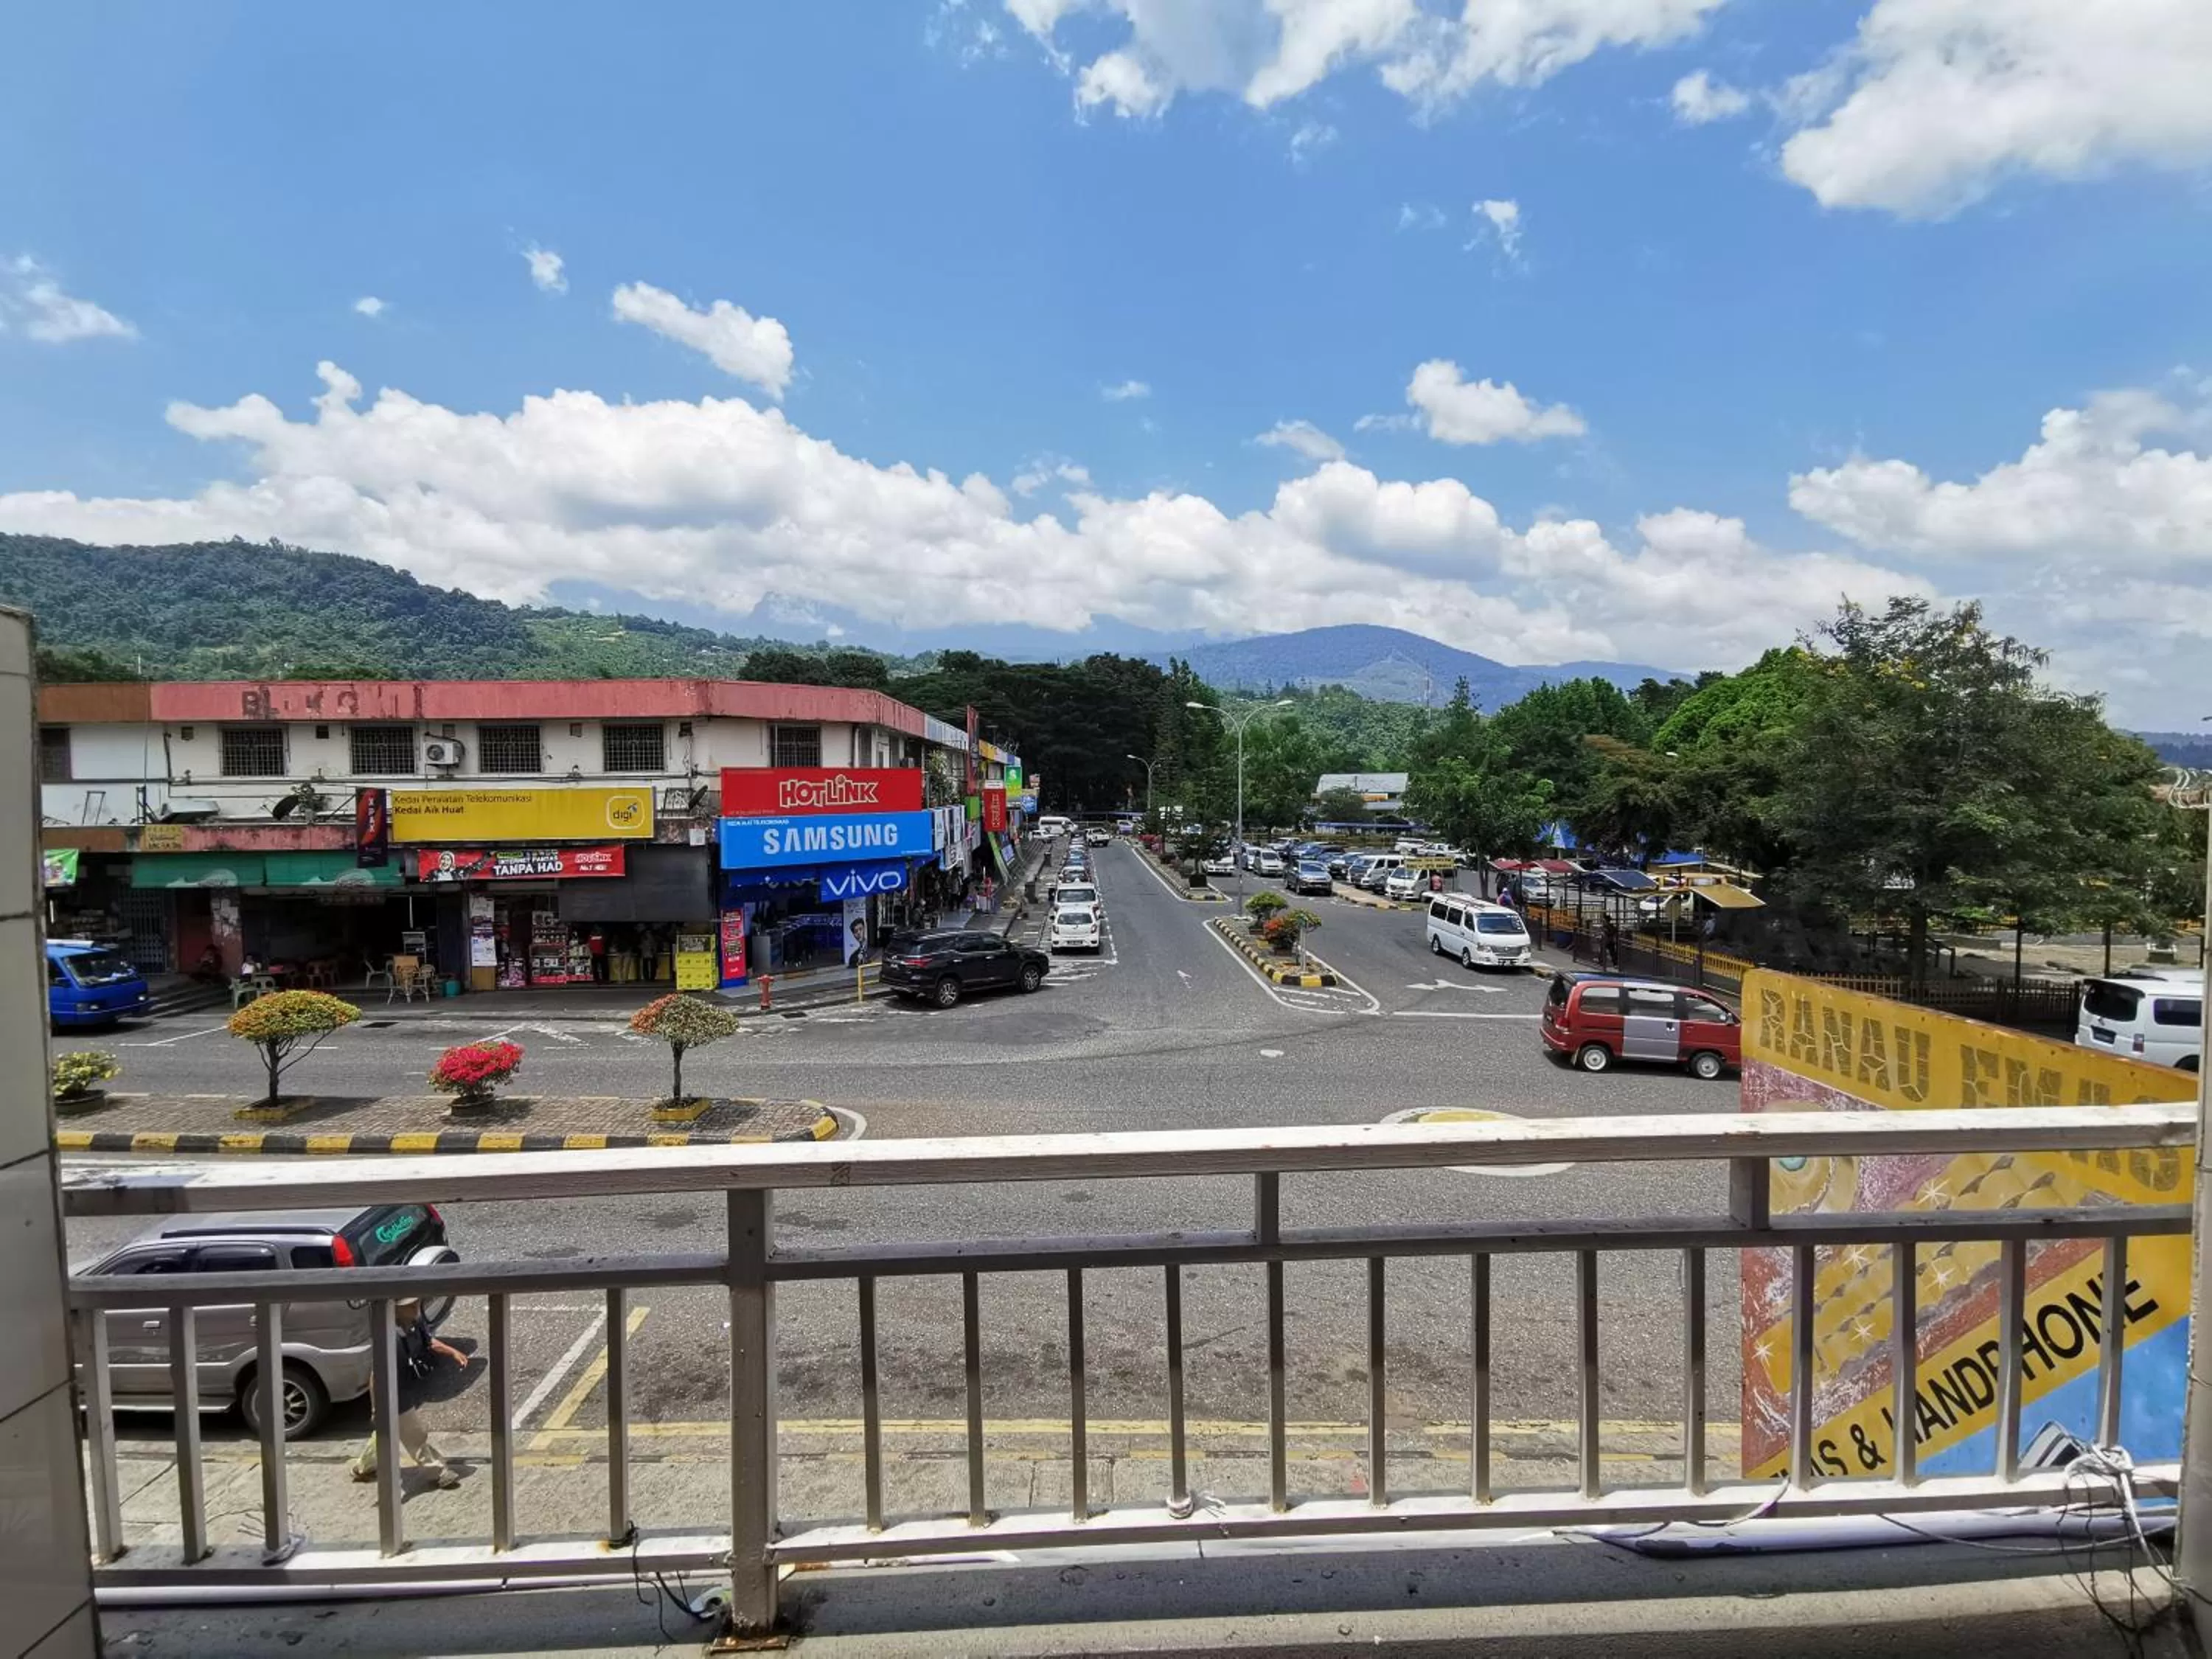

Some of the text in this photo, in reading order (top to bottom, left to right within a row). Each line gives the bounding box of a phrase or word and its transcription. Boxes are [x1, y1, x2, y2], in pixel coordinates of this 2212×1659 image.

[466, 794, 532, 803] Telekomunikasi
[394, 806, 422, 814] Kedai
[613, 808, 633, 823] digi
[763, 823, 898, 855] SAMSUNG
[493, 861, 564, 876] TANPA HAD
[1760, 988, 1931, 1103] RANAU
[1850, 1424, 1887, 1470] &
